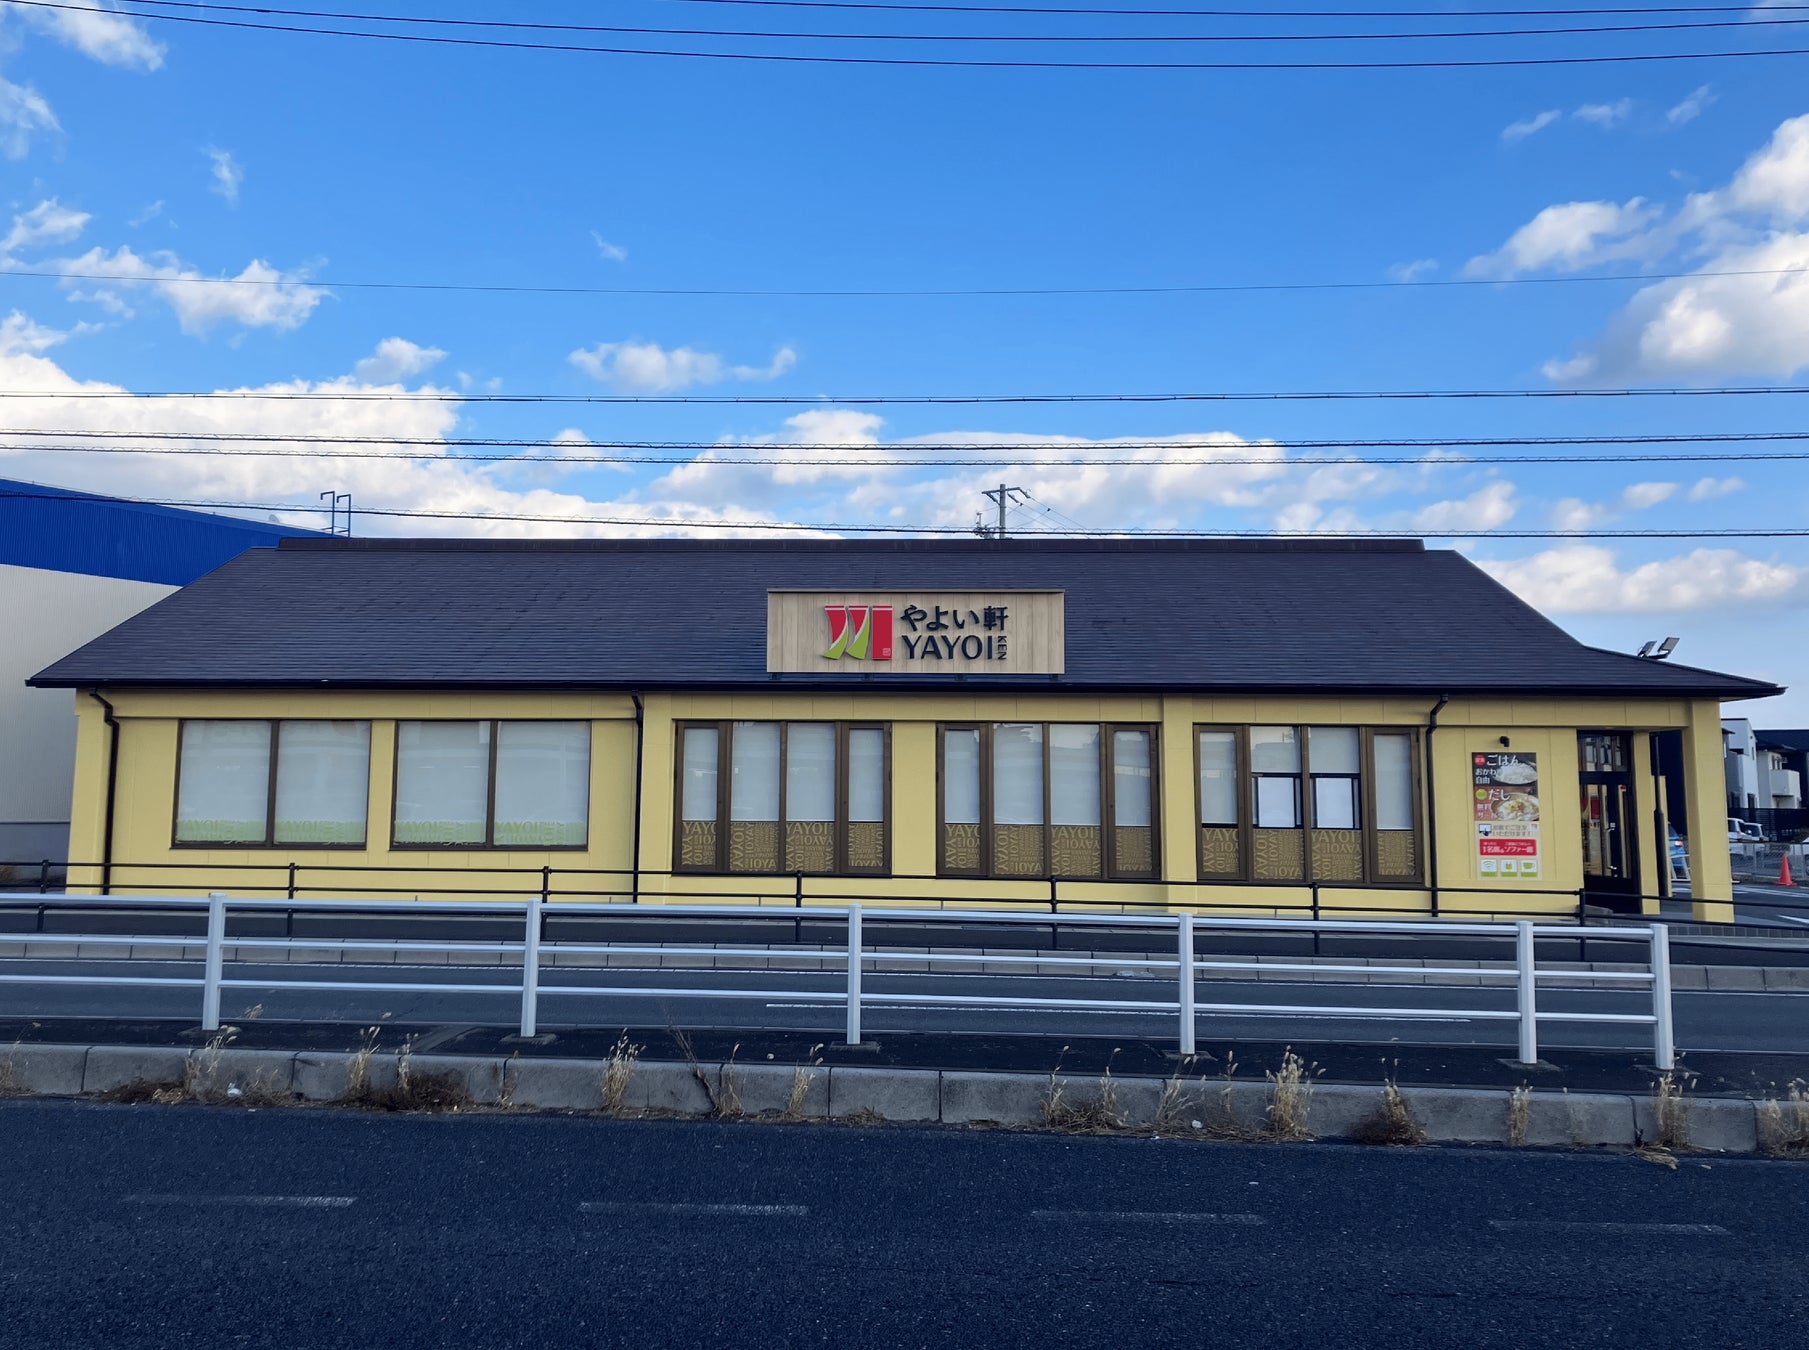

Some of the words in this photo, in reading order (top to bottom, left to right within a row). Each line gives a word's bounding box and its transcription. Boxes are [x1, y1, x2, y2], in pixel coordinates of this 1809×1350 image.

[900, 604, 1009, 631] やよい軒
[902, 635, 993, 660] YAYOI
[997, 635, 1007, 660] KEN
[1487, 754, 1519, 766] ごはん
[1488, 788, 1511, 801] だし
[786, 822, 828, 835] YAYOI
[1051, 826, 1094, 839] YAYOI
[1311, 830, 1355, 843] YAYOI
